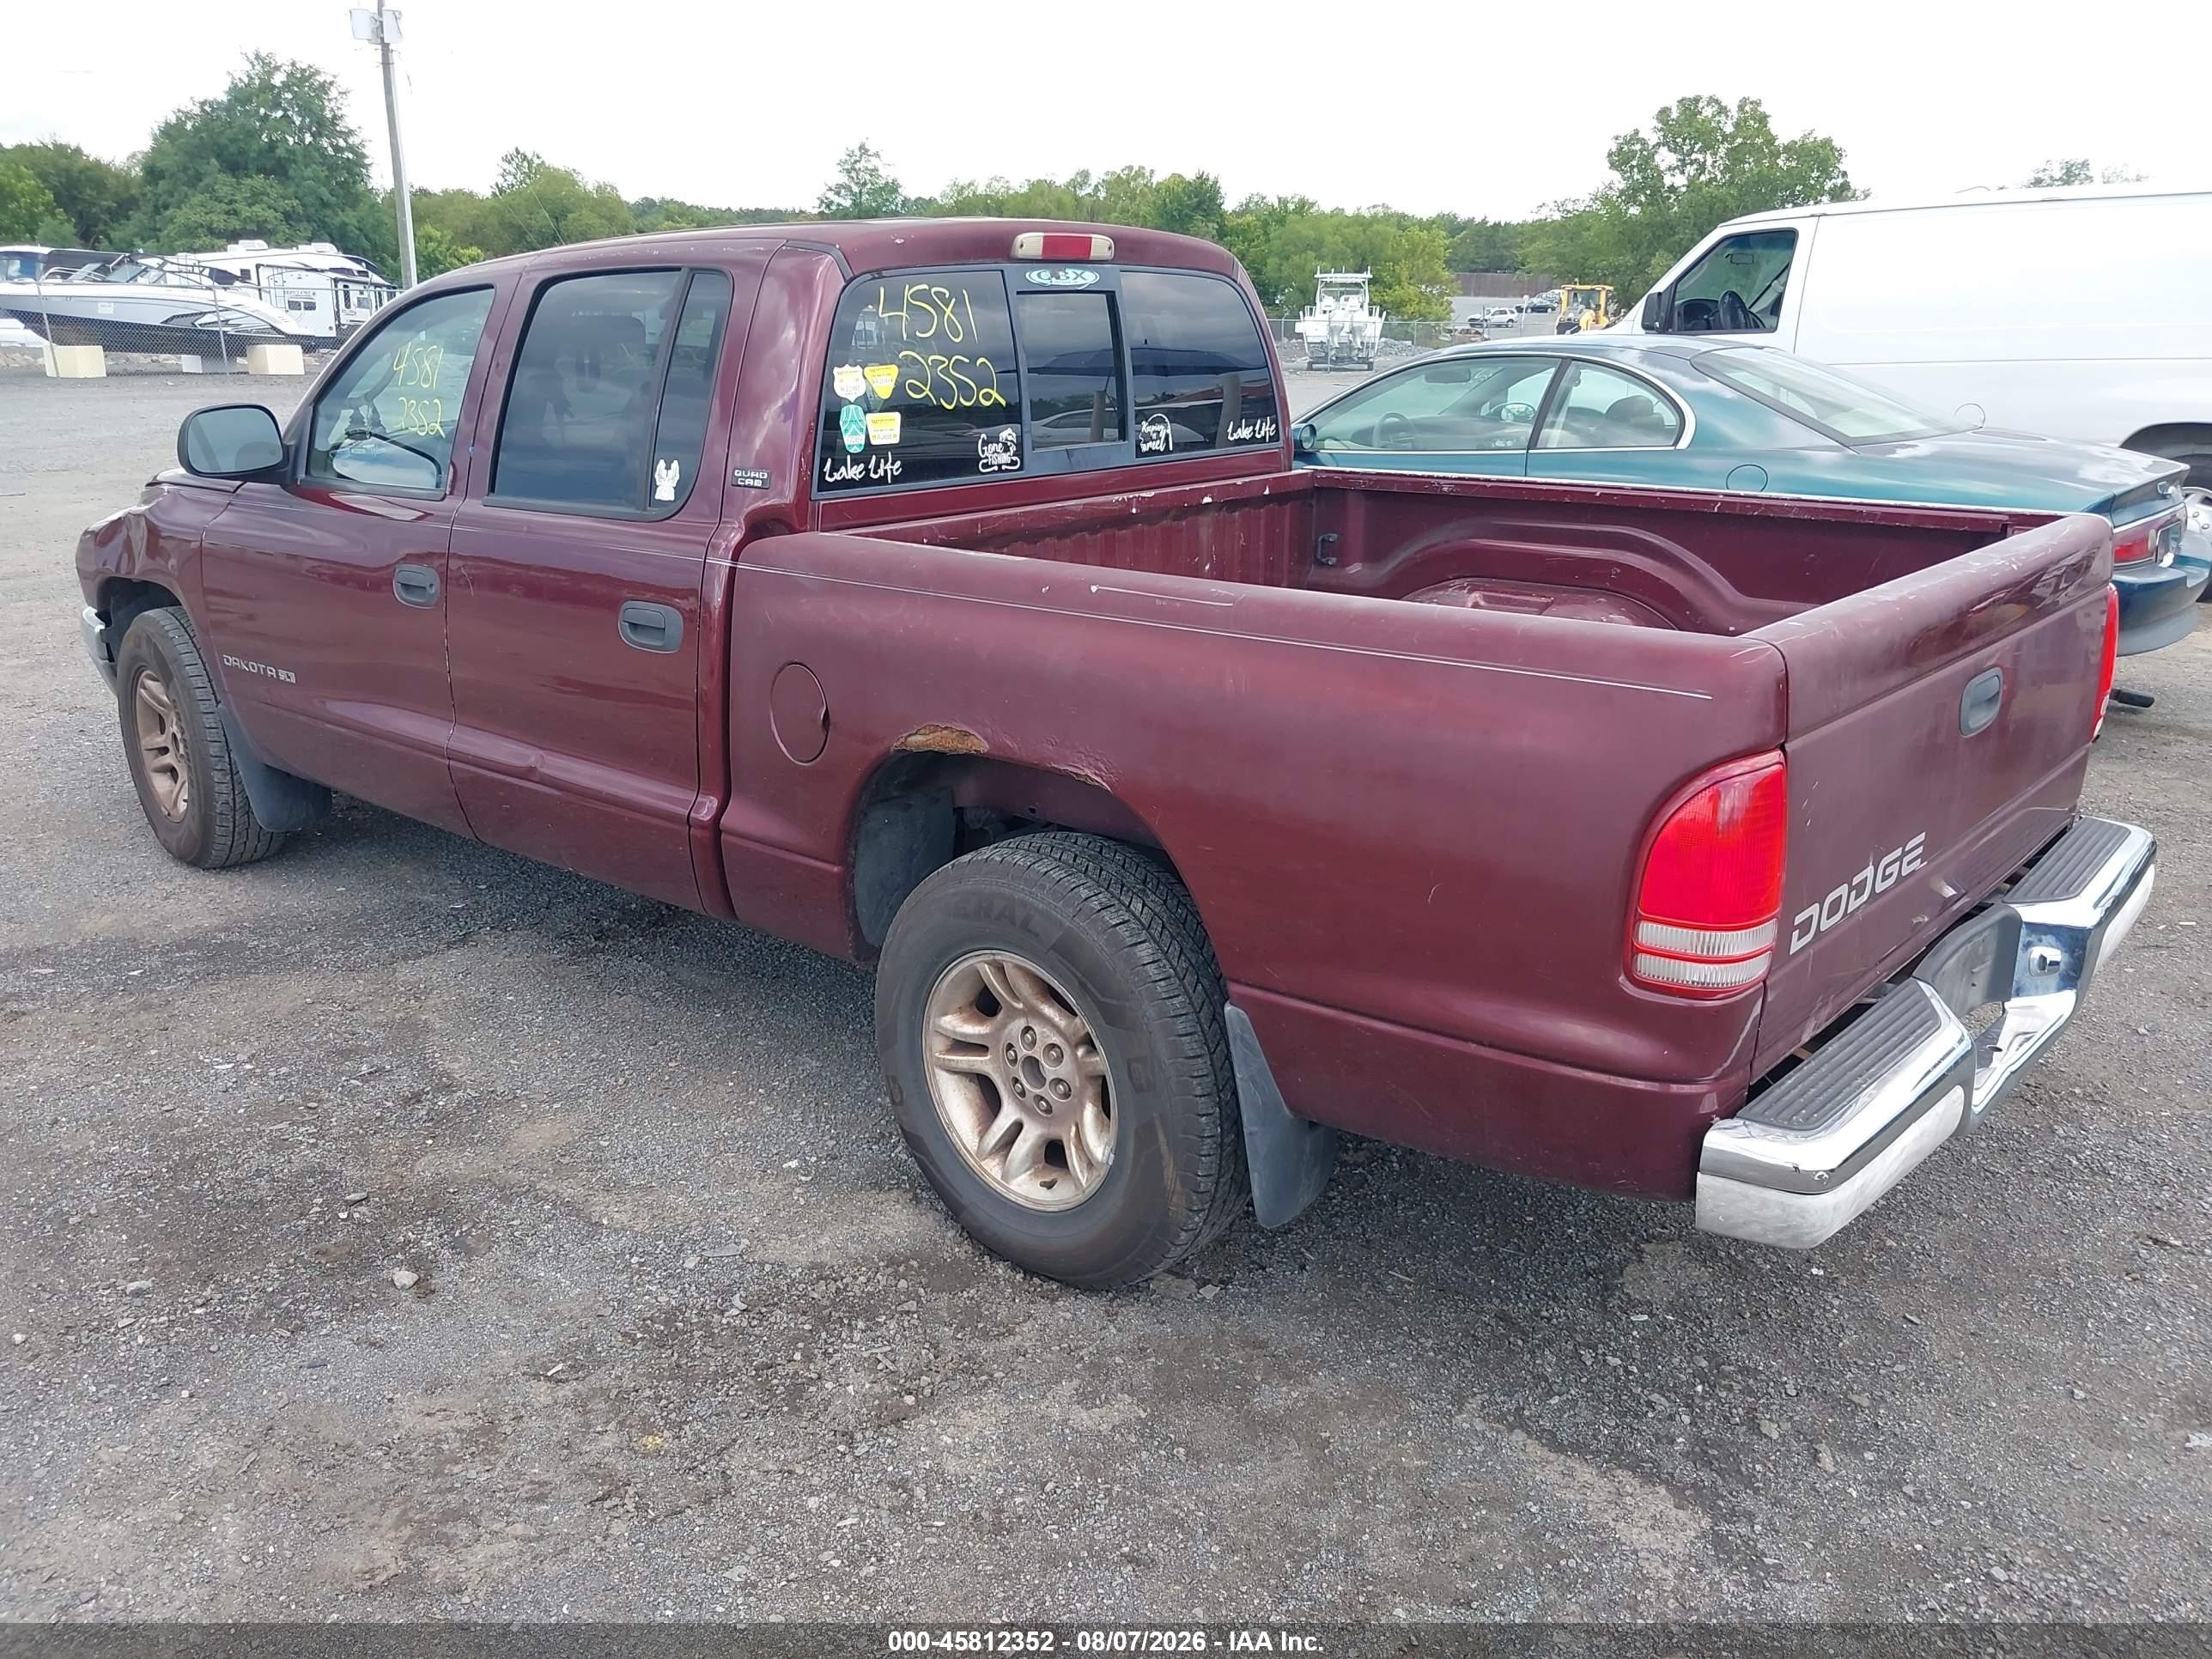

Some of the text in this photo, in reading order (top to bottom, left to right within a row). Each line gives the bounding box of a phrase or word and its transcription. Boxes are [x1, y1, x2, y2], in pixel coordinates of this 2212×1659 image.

[878, 284, 978, 343] 4581
[393, 342, 444, 392] 4581
[899, 350, 1006, 410] 2352
[395, 397, 446, 439] 2352
[1227, 416, 1277, 442] Lake Life
[978, 433, 1005, 459] Gone
[988, 453, 1011, 465] FISHING
[734, 469, 768, 479] QUAD
[823, 451, 902, 483] Lake Life
[738, 477, 763, 487] CAB
[222, 654, 276, 678] DAKOTA
[1790, 831, 1926, 955] DODGE
